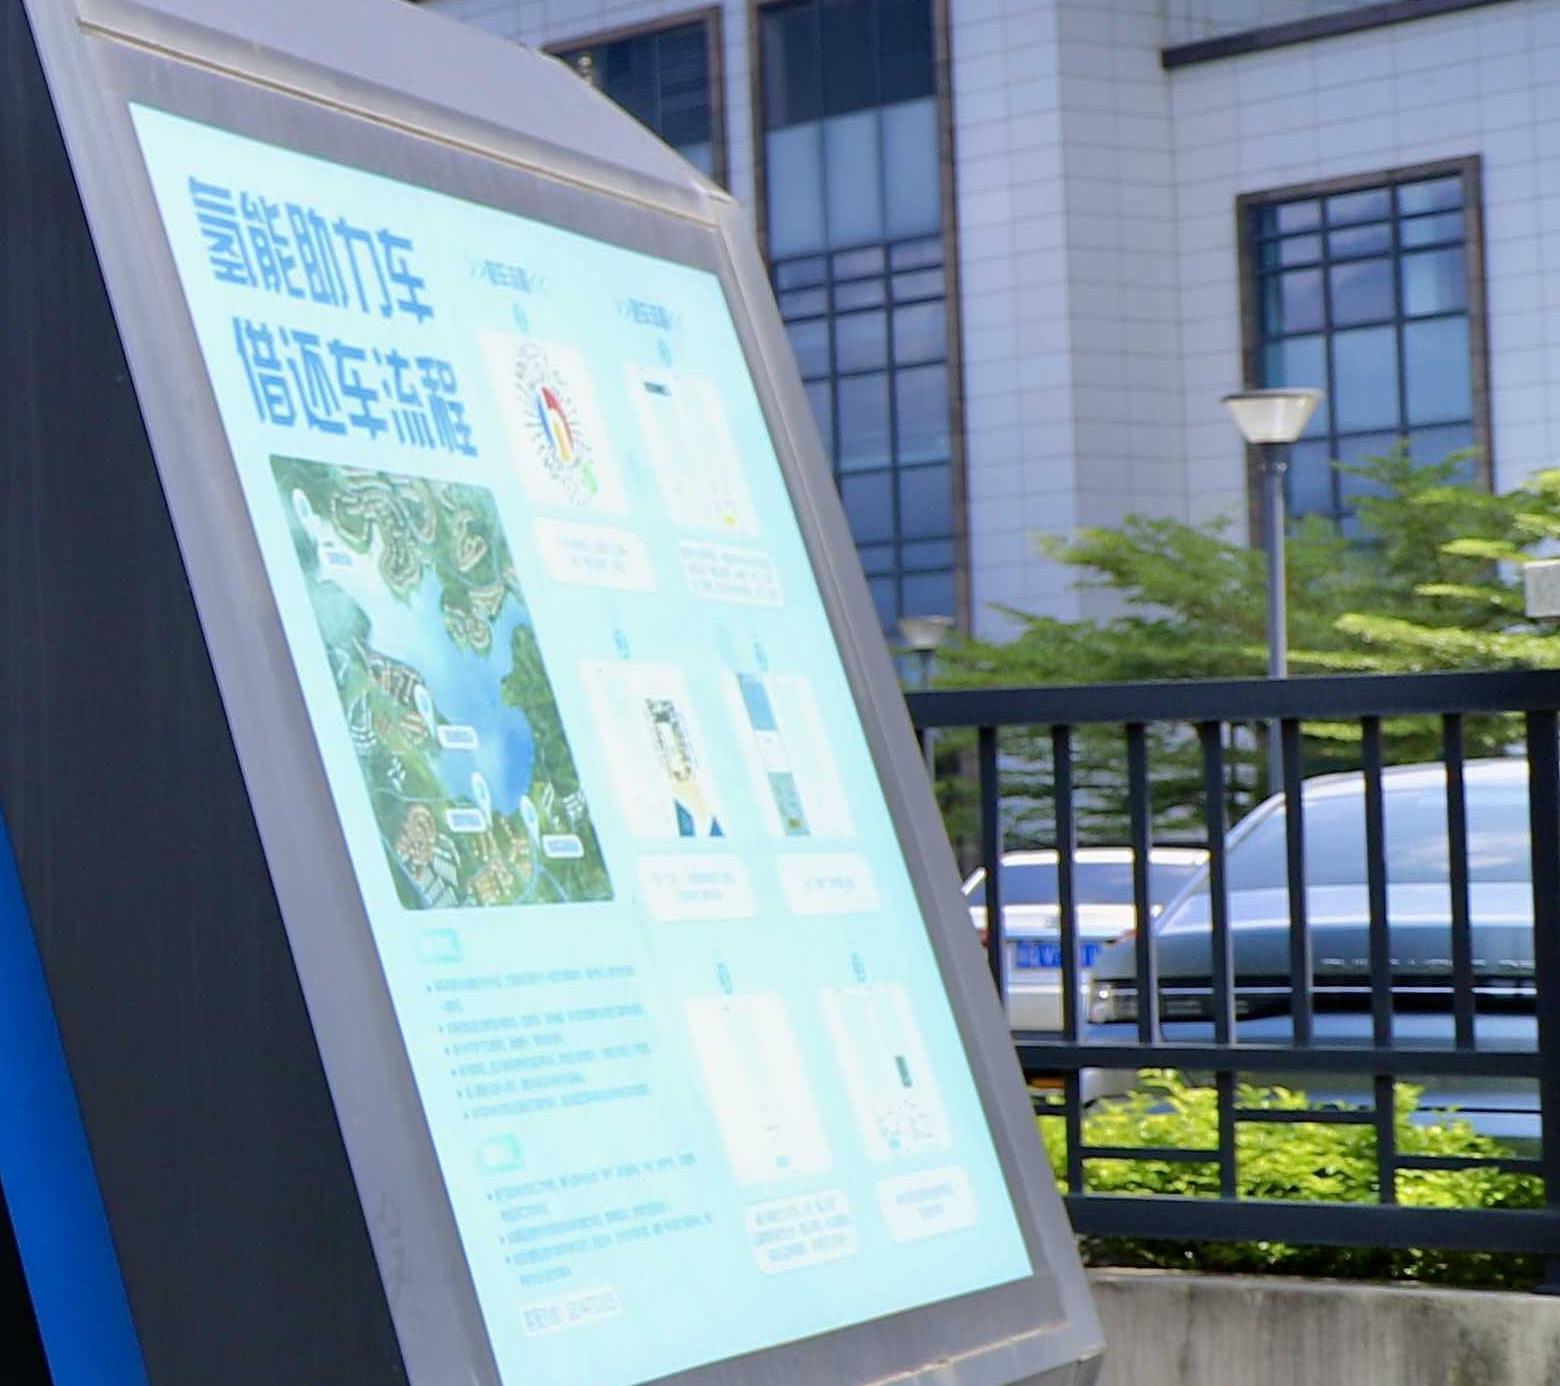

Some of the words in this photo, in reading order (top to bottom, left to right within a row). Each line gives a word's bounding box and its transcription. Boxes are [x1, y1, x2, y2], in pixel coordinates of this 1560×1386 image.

[188, 176, 434, 324] 氢能助力车
[232, 316, 478, 457] 借还车流程
